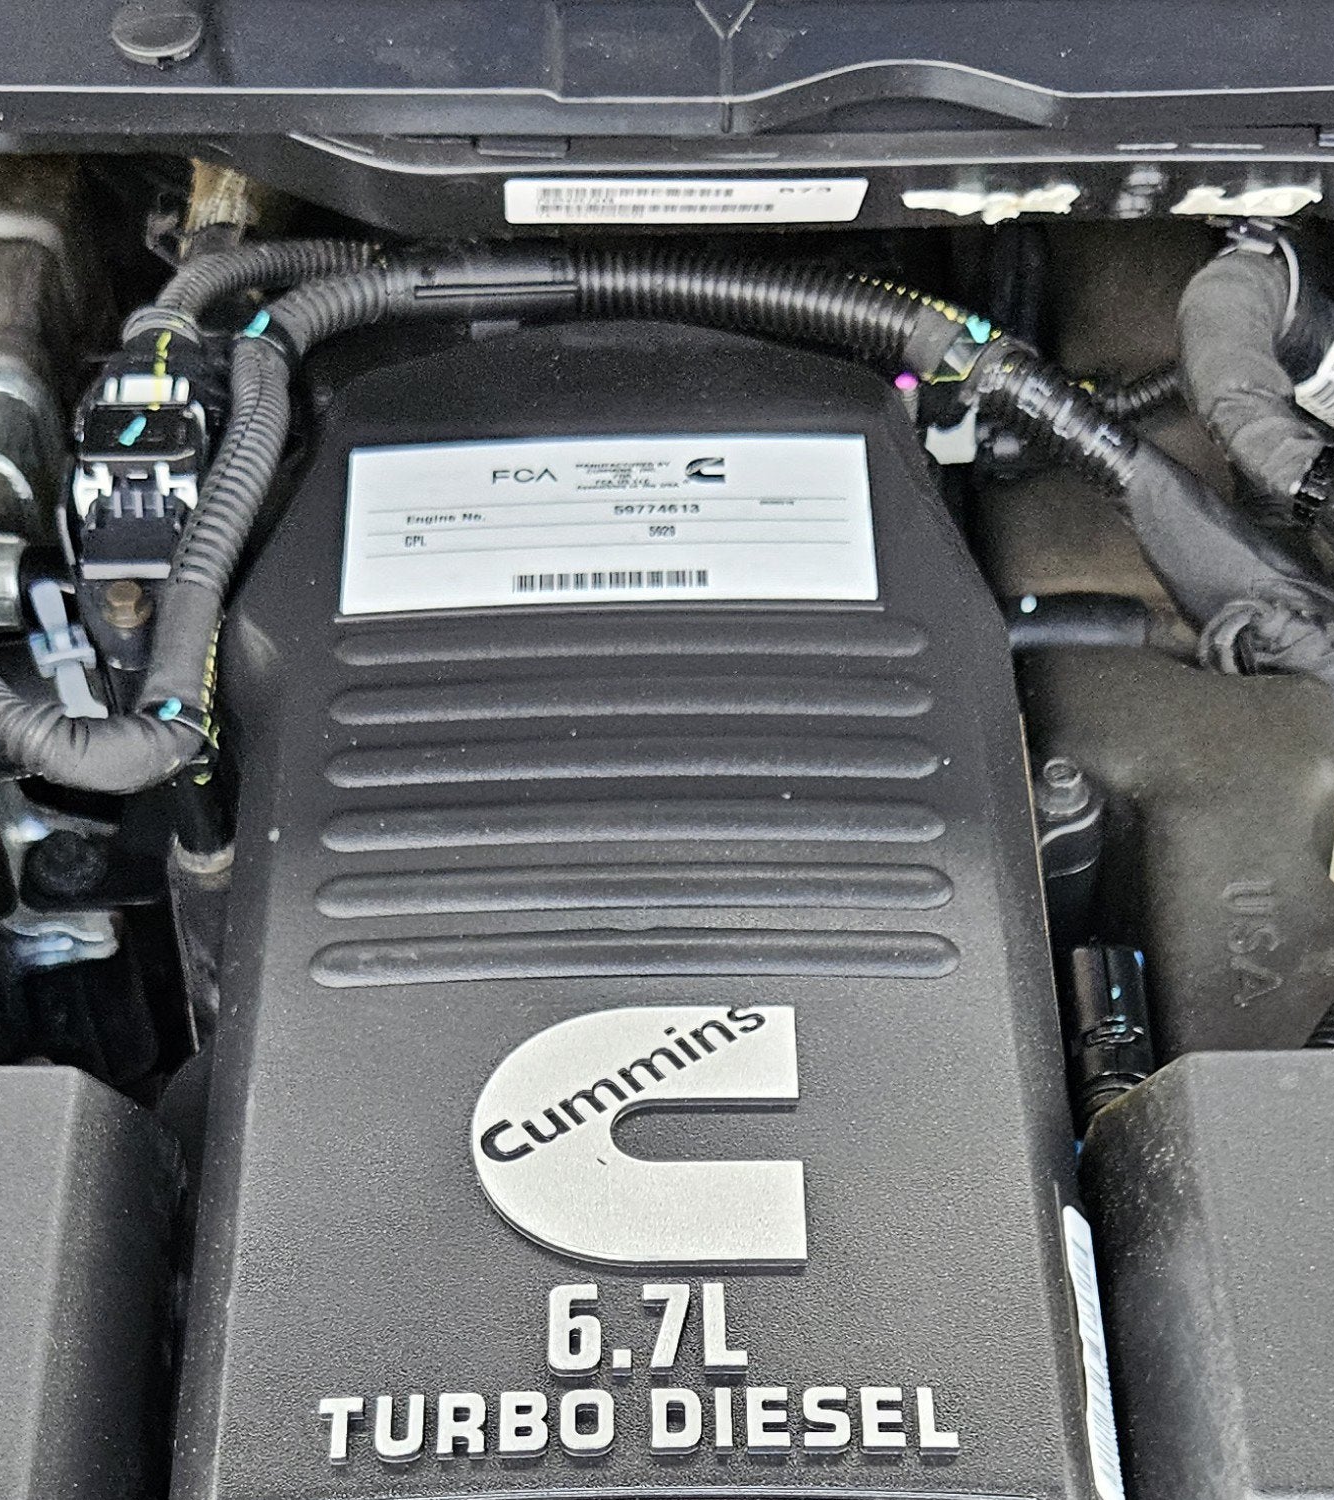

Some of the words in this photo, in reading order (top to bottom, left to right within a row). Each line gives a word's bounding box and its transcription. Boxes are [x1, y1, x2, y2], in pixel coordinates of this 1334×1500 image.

[405, 514, 456, 526] Engine
[613, 503, 701, 516] 59774613
[492, 468, 558, 485] FCA
[404, 534, 428, 549] CPL
[1222, 878, 1282, 1008] USA
[478, 1003, 768, 1164] Cummins
[547, 1282, 749, 1377] 6.7L
[319, 1387, 615, 1464] TURBO
[649, 1385, 960, 1457] DIESEL
